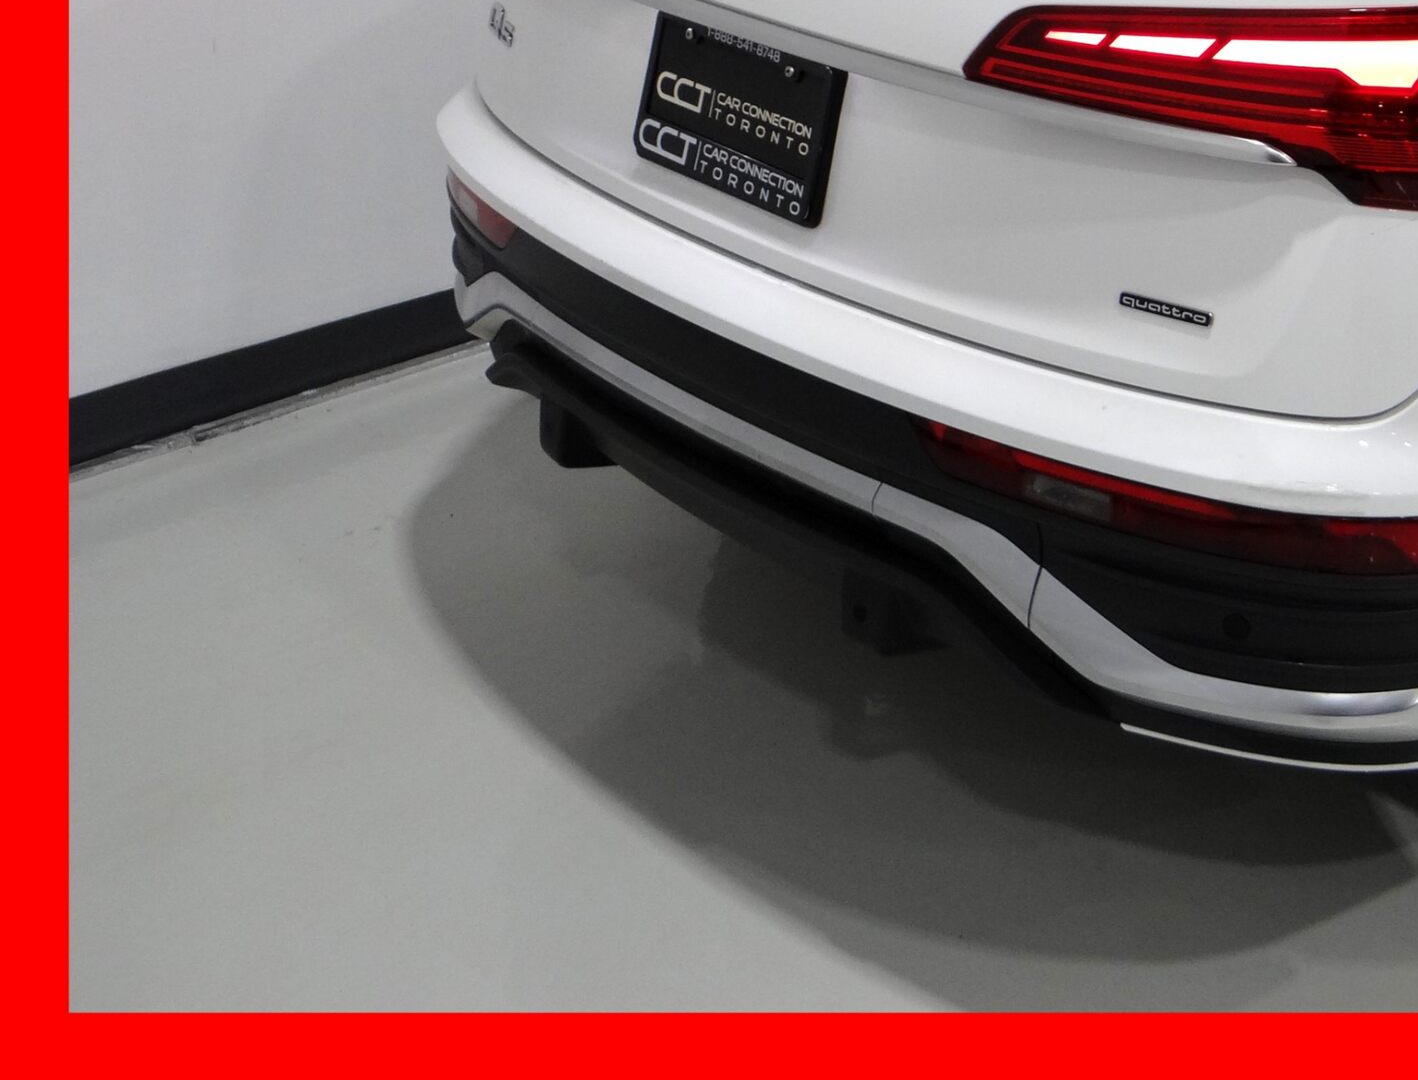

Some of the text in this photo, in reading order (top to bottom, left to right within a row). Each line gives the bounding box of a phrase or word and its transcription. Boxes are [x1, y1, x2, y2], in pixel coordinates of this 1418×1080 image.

[656, 70, 712, 114] CCT
[716, 92, 813, 139] CAR CONNECTION
[638, 118, 698, 166] CCT
[714, 107, 809, 156] TORONTO
[700, 160, 800, 216] TORONTO
[703, 143, 804, 198] CAR CONNECTION
[1121, 295, 1208, 324] quattro
